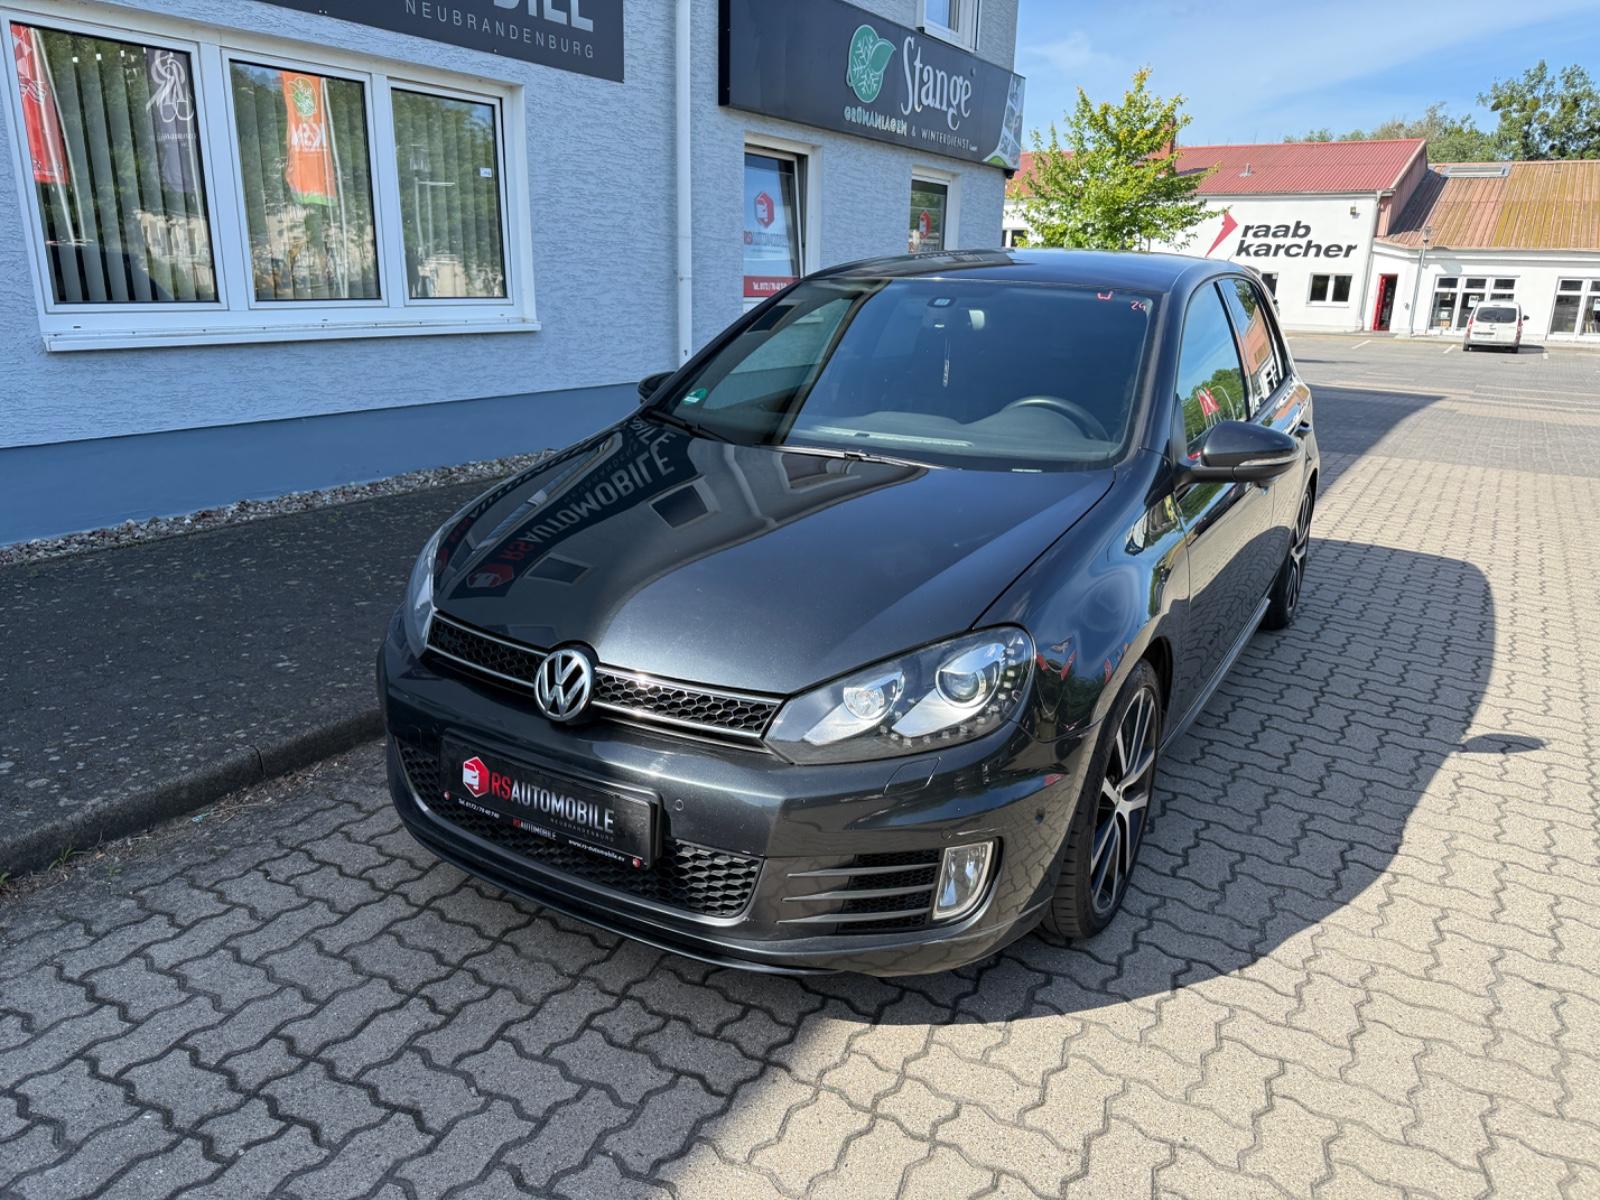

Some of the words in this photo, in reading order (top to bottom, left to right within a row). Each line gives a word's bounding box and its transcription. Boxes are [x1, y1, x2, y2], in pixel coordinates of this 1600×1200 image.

[405, 0, 594, 59] NEUBRANDENBURG
[901, 36, 972, 131] Stange
[1241, 220, 1312, 239] raab
[1235, 240, 1358, 259] karcher
